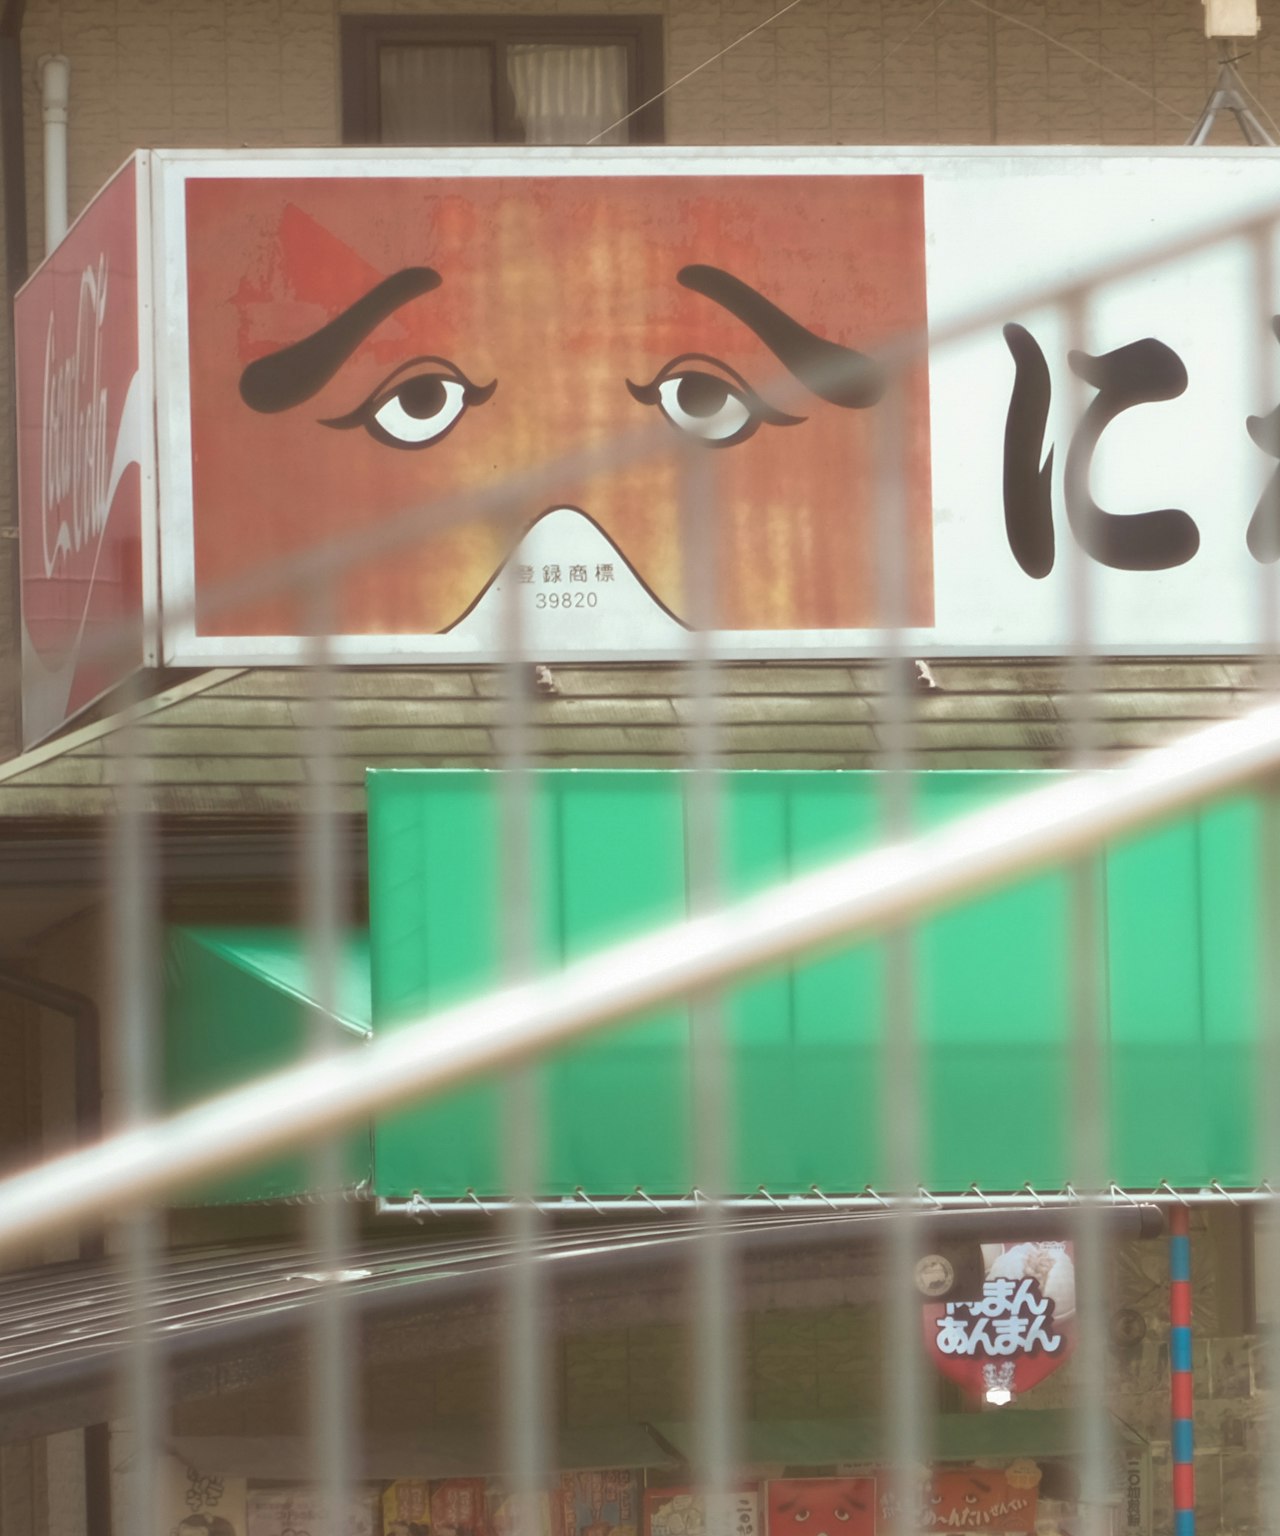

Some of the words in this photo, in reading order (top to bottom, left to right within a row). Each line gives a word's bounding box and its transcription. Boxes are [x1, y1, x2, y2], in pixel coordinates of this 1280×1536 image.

[515, 563, 615, 583] 登録商標
[536, 592, 597, 609] 39820
[935, 1315, 1062, 1356] あんまん
